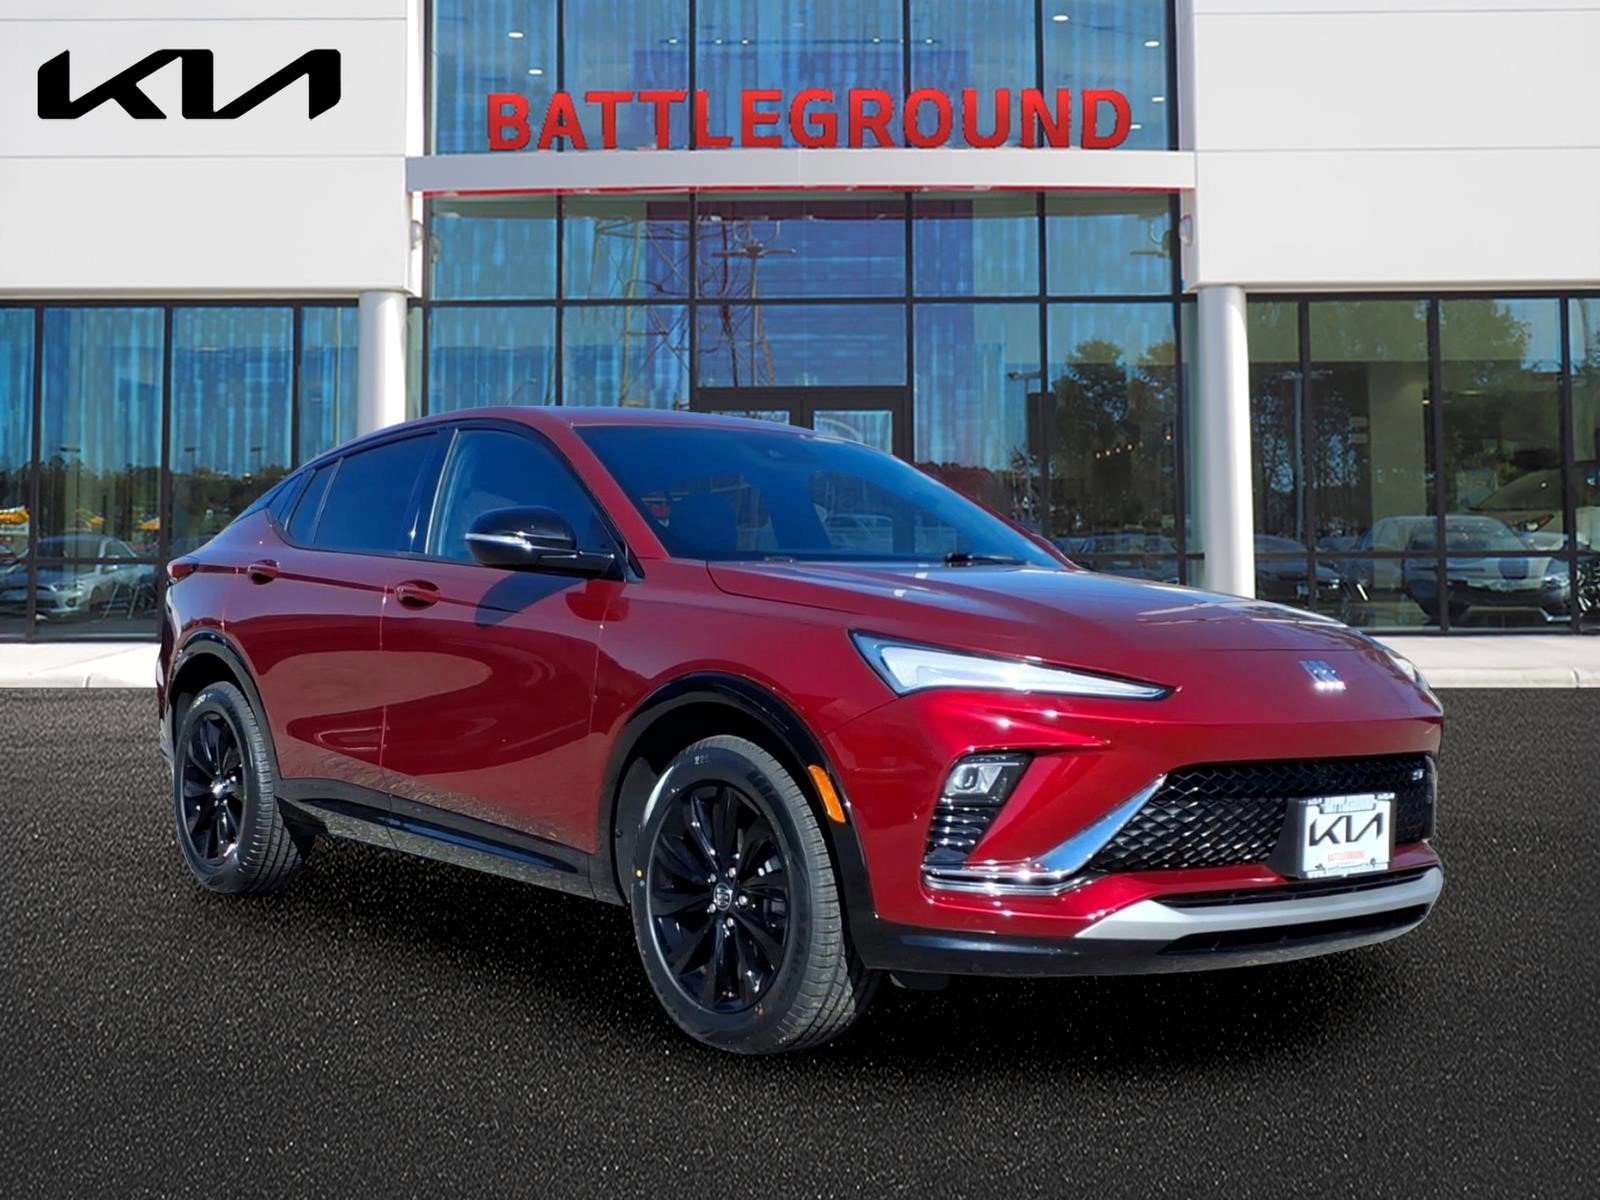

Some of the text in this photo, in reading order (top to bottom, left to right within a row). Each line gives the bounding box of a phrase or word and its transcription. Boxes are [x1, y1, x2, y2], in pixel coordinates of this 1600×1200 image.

[37, 49, 341, 120] KIA
[487, 87, 1132, 151] BATTLEGROUND
[1308, 812, 1384, 847] KIA
